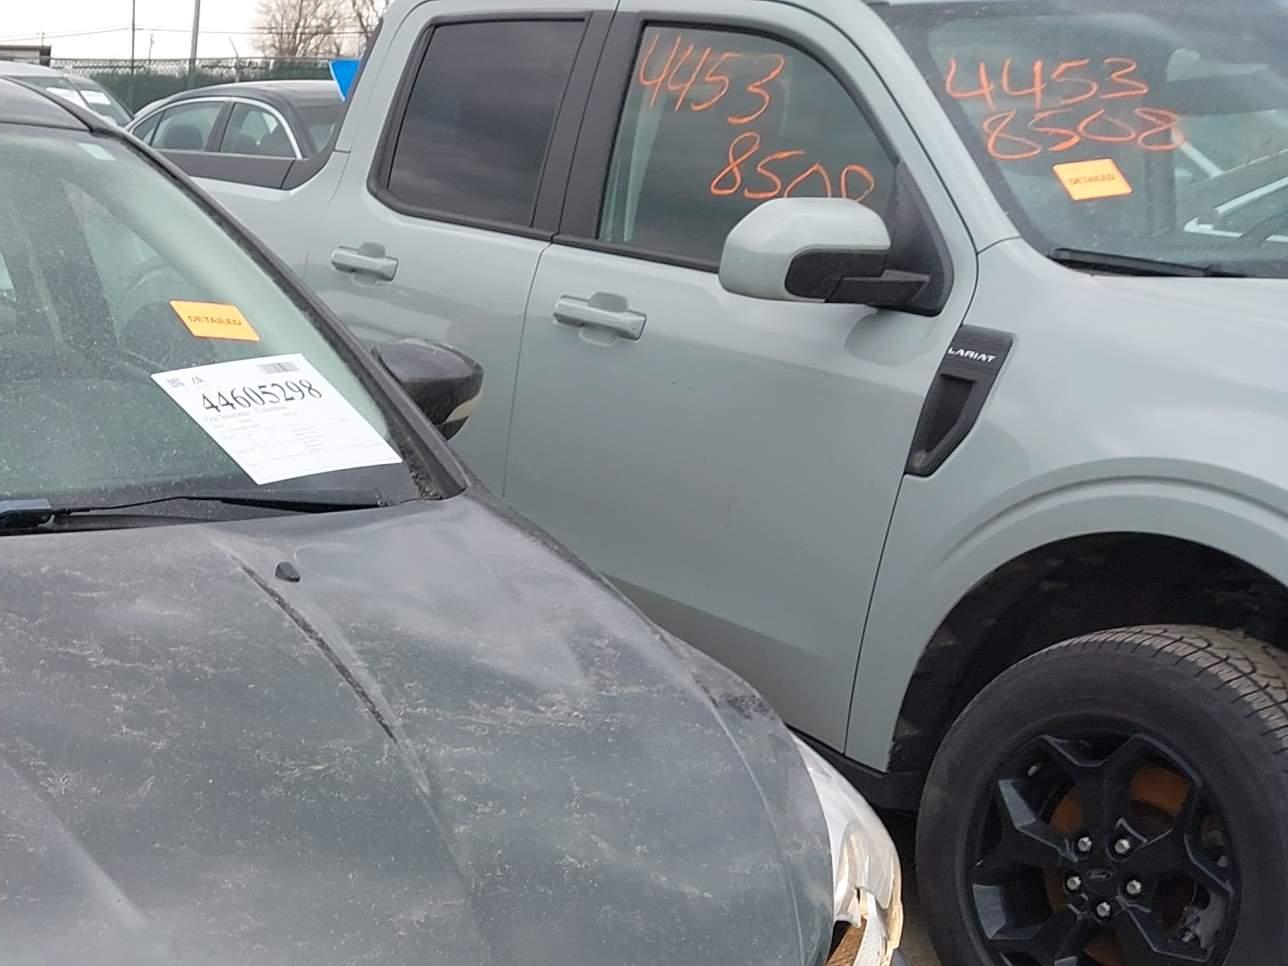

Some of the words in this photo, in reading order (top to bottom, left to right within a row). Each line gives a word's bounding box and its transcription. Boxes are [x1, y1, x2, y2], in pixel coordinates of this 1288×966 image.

[638, 33, 785, 126] 4453
[944, 56, 1149, 111] 4453
[982, 107, 1187, 160] 8508
[947, 347, 996, 362] LARIAT
[201, 378, 323, 413] 44605298
